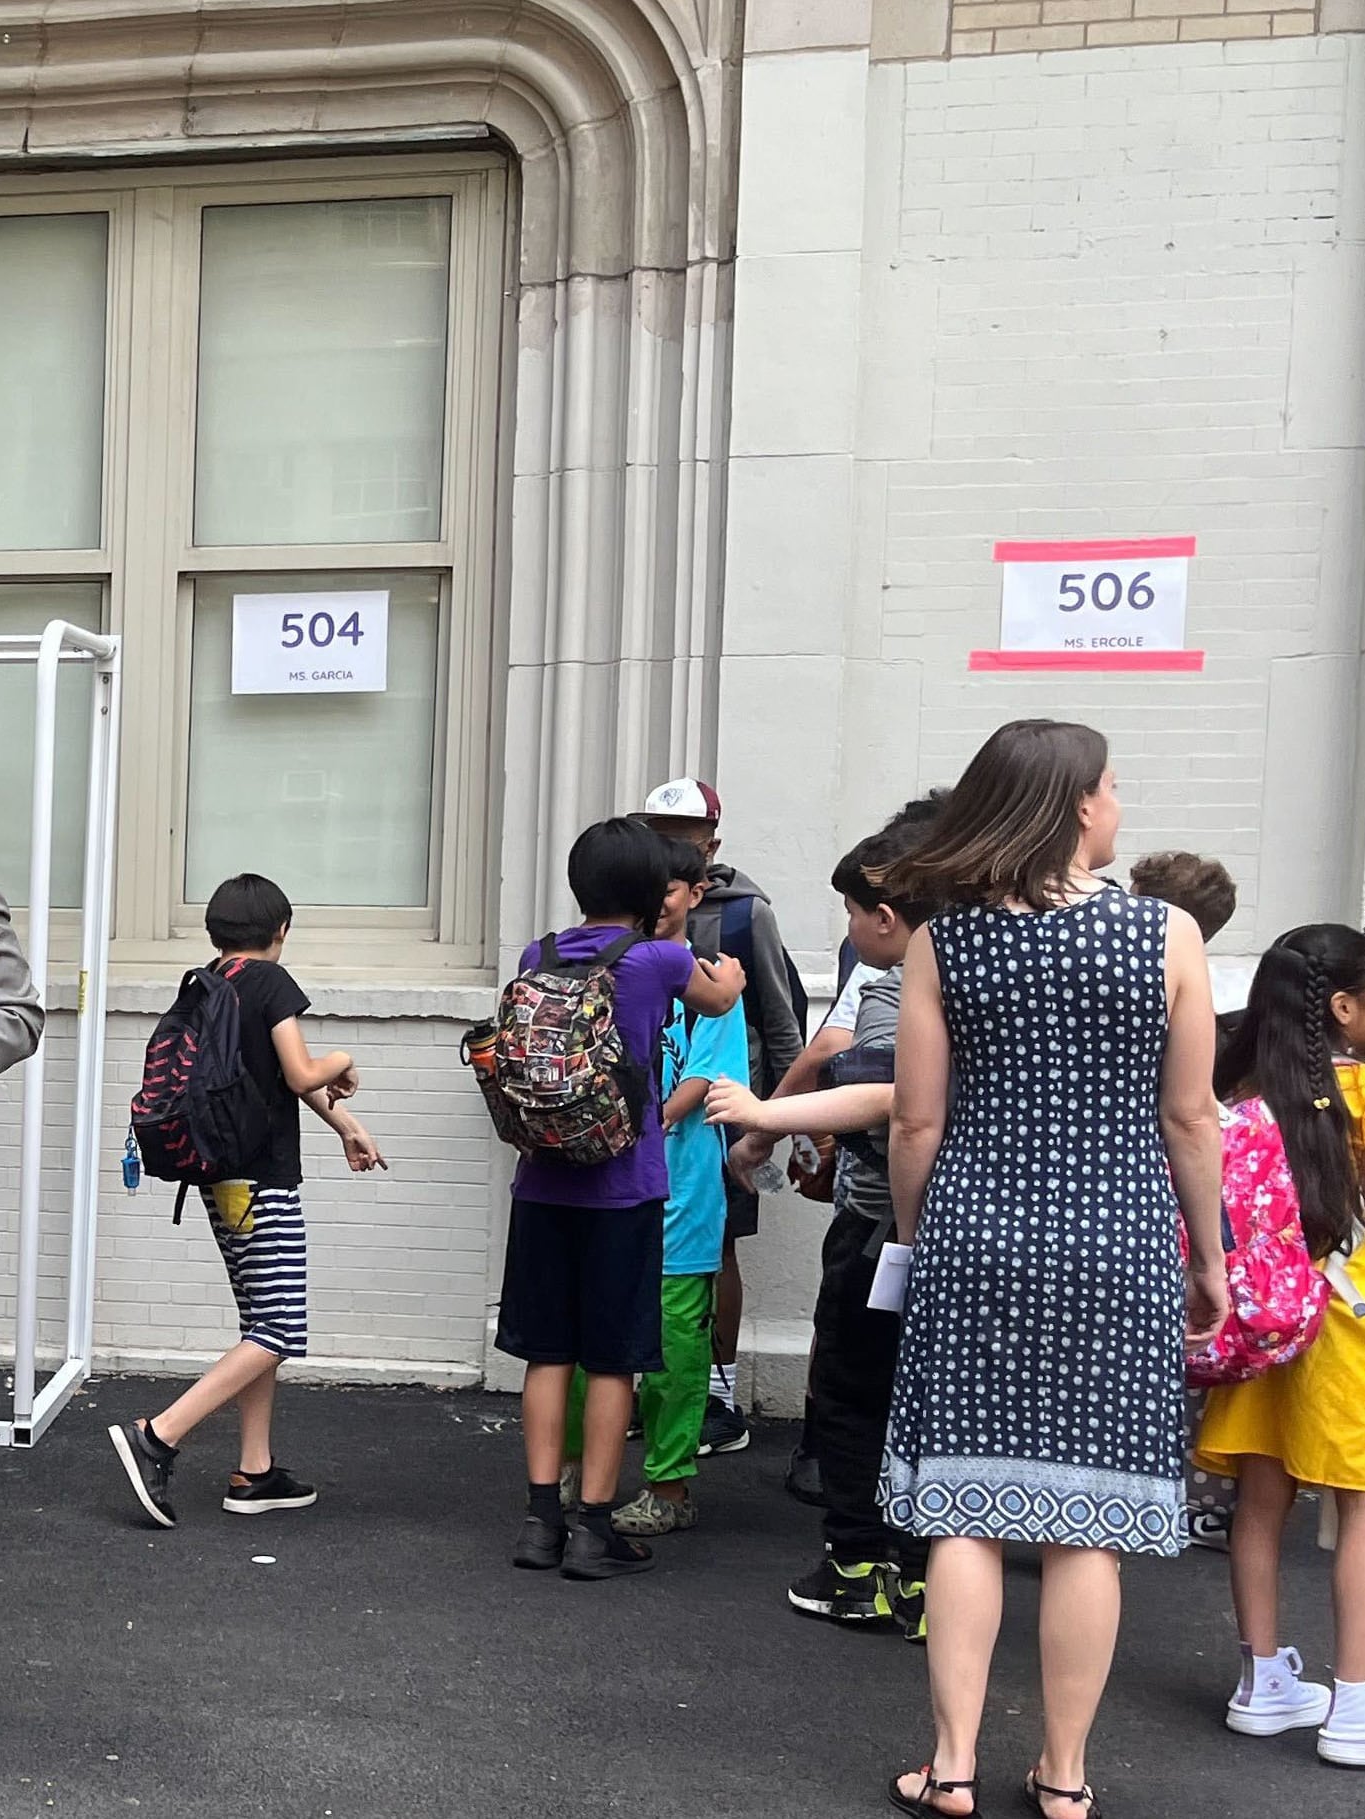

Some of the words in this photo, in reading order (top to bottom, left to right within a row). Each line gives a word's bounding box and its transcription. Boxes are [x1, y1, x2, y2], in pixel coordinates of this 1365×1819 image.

[1058, 571, 1155, 612] 506
[281, 611, 364, 648] 504
[1064, 638, 1086, 648] MS.
[1091, 636, 1144, 648] ERCOLE
[289, 671, 308, 681] MS.
[311, 670, 354, 681] GARCIA
